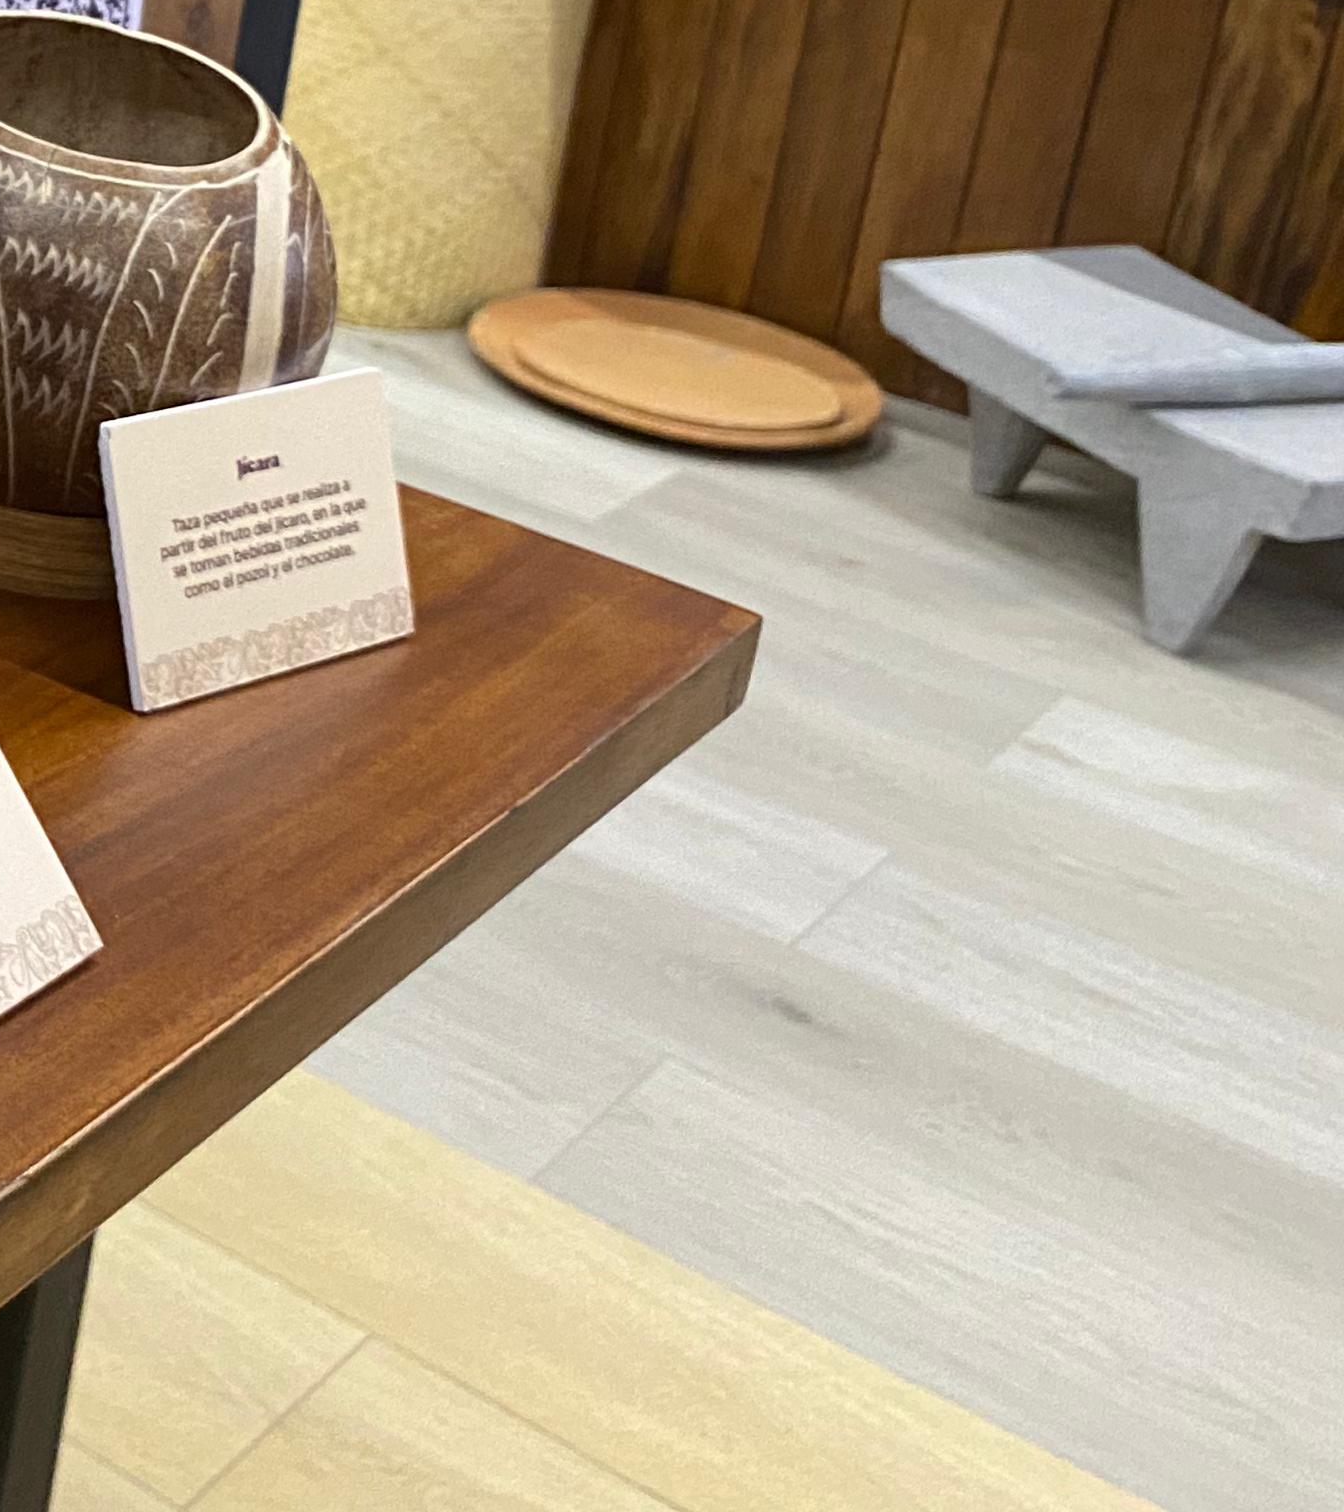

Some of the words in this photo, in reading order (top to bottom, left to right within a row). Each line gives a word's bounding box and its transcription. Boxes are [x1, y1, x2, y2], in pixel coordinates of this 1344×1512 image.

[161, 541, 194, 561] partir
[199, 535, 217, 549] del
[220, 528, 251, 544] fruto
[254, 520, 272, 536] del
[313, 508, 328, 520] en
[330, 504, 341, 516] la
[343, 499, 366, 515] que
[172, 517, 200, 532] Taza
[204, 503, 258, 528] pequeña
[261, 497, 284, 513] que
[287, 494, 300, 504] se
[303, 483, 341, 500] realiza
[174, 565, 187, 577] se
[190, 554, 232, 573] toman
[234, 541, 282, 563] bebidas
[284, 521, 359, 549] tradicionales
[185, 580, 220, 598] como
[223, 574, 234, 588] el
[236, 565, 270, 585] pozol
[282, 559, 293, 572] el
[295, 544, 356, 571] chocolate.
